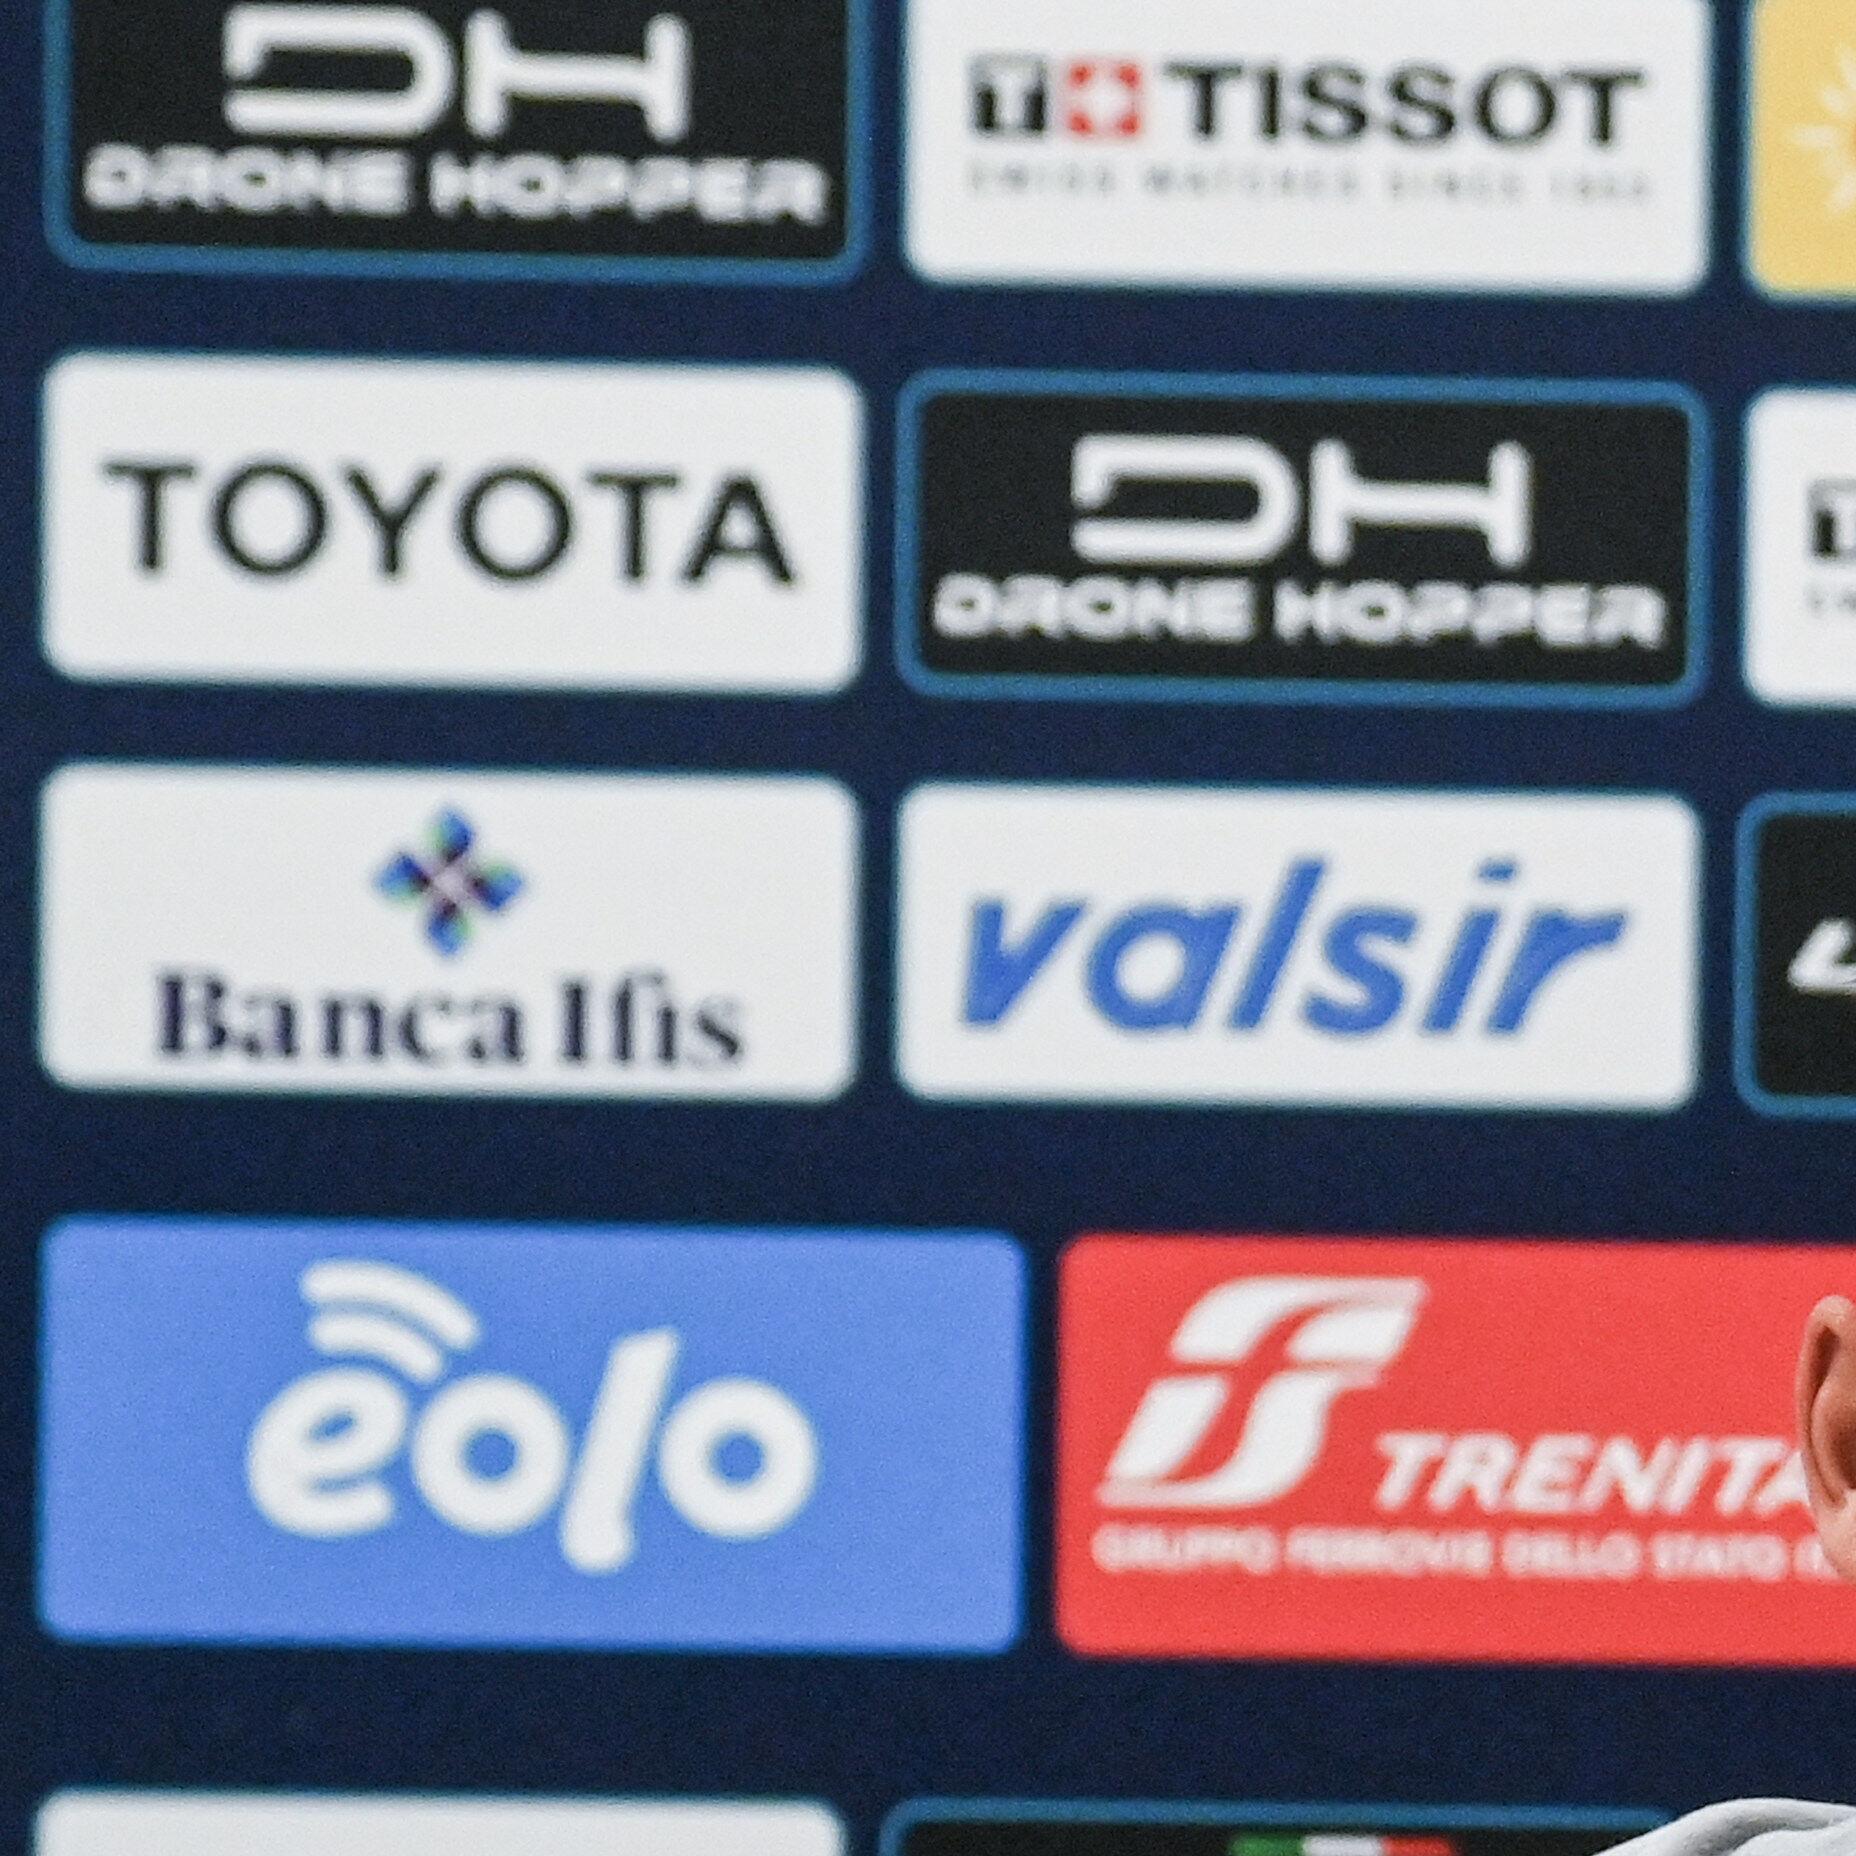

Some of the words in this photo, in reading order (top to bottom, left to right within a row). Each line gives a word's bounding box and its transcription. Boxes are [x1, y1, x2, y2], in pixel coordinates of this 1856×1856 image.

[1165, 62, 1644, 147] TISSOT
[84, 145, 410, 215] DRONE
[429, 153, 827, 223] HOPPER
[104, 460, 796, 587] TOYOTA
[934, 574, 1254, 641] DRONE
[1274, 580, 1666, 648] HOPPER
[960, 857, 1629, 1040] valsir
[158, 972, 524, 1065] Banca
[561, 974, 743, 1067] Ifis
